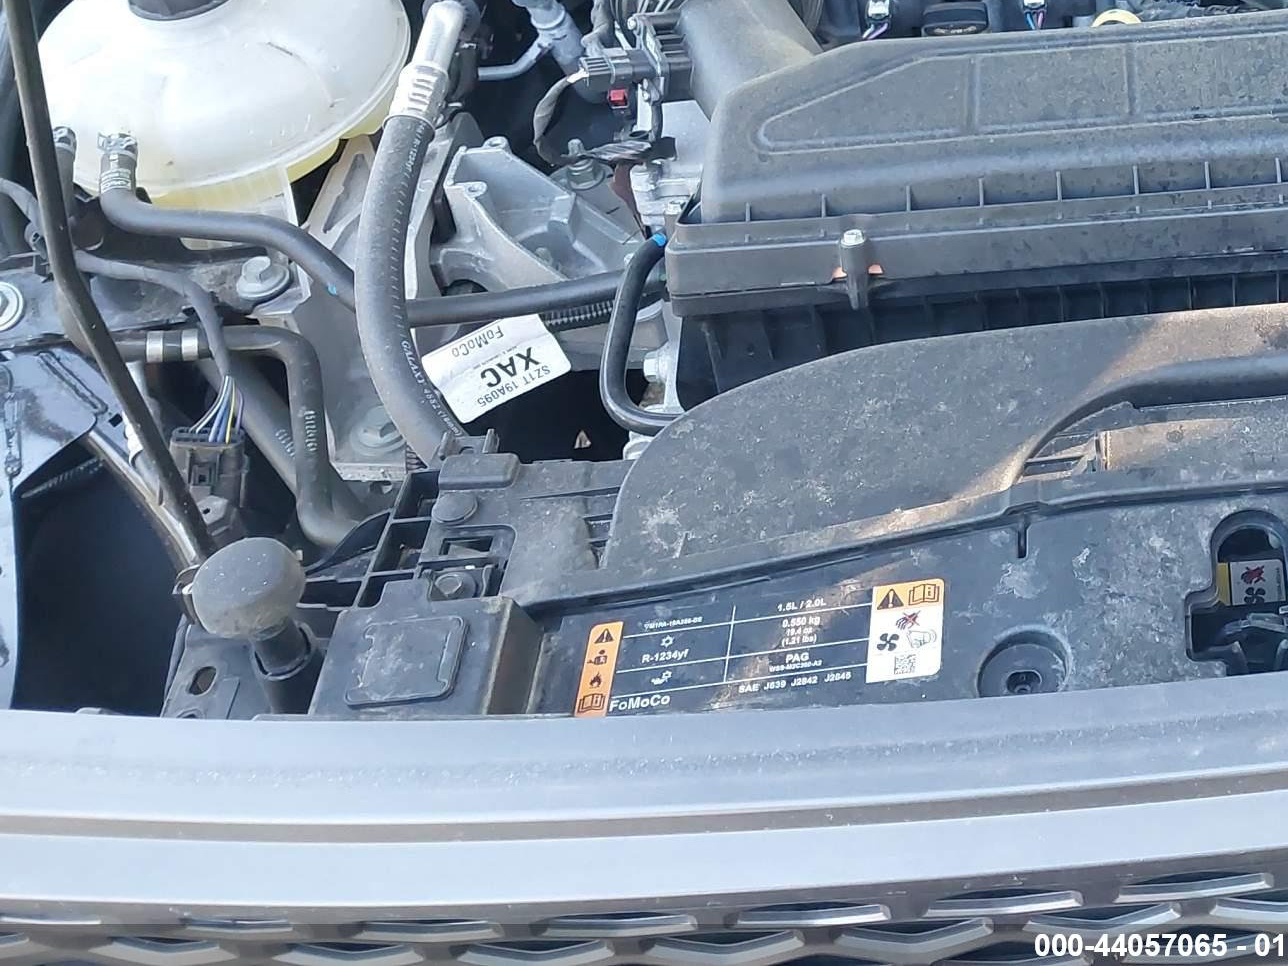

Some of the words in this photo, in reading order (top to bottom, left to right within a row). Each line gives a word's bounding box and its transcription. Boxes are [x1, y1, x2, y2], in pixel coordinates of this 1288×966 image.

[451, 325, 505, 358] FoMoCo
[480, 346, 542, 388] XAC
[523, 365, 551, 386] SZ1T
[476, 381, 519, 408] 19A095
[806, 598, 827, 609] 2.0L
[808, 615, 821, 626] kg
[641, 648, 689, 664] R-1234yf
[785, 652, 810, 663] PAG
[738, 683, 760, 693] SAE
[608, 694, 671, 712] FoMoCo
